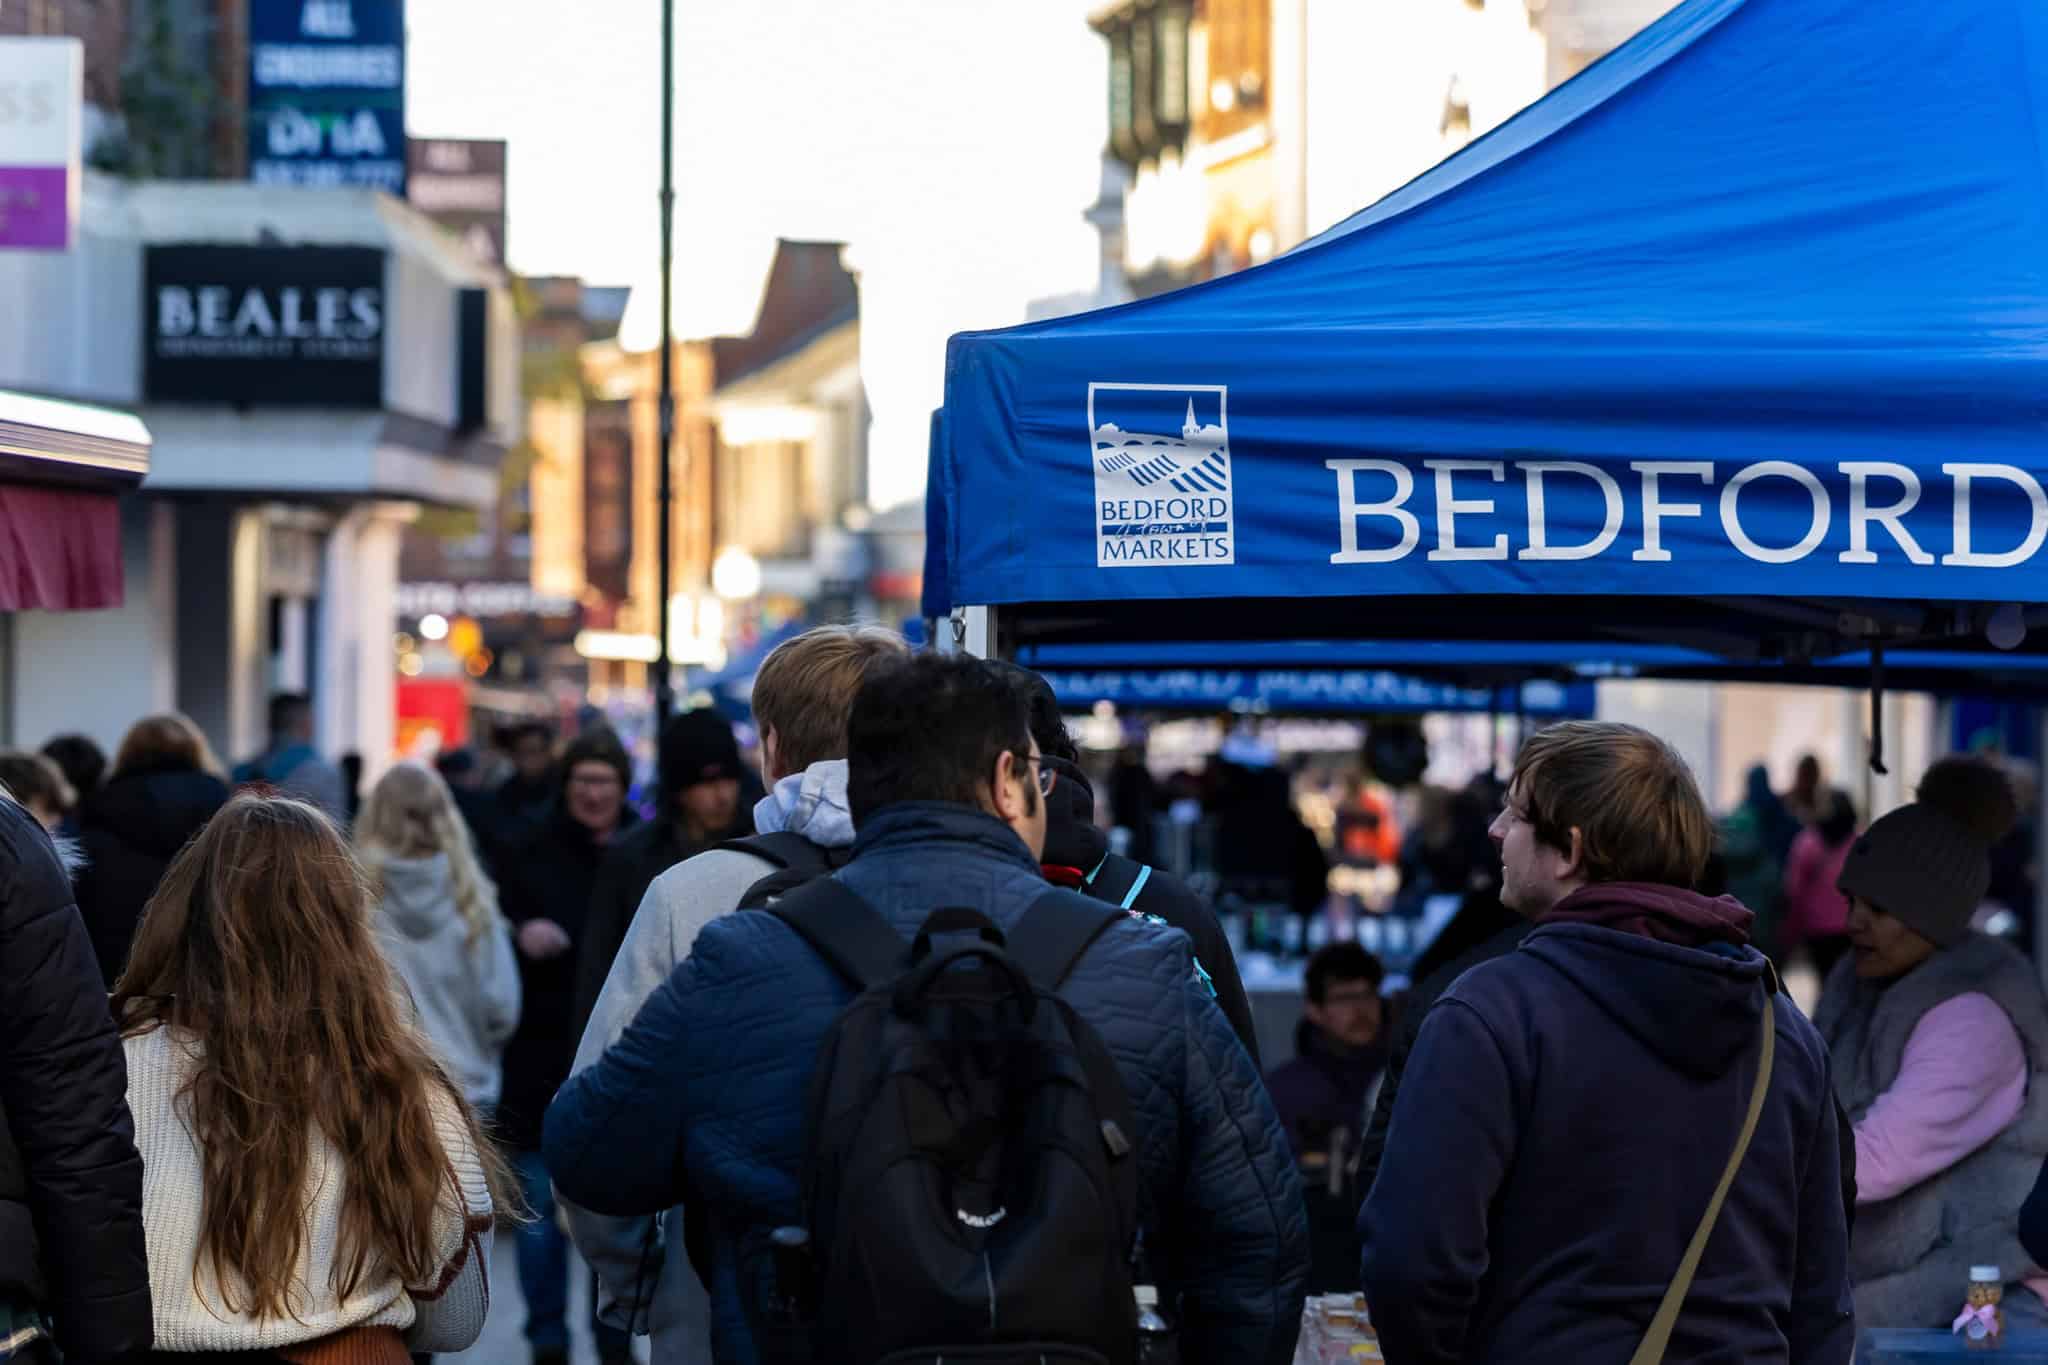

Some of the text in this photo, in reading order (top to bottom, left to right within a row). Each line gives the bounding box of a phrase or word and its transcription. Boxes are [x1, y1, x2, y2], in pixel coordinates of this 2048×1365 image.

[158, 285, 381, 339] BEALES
[1102, 498, 1227, 521] BEDFORD
[1325, 458, 2048, 568] BEDFORD
[1103, 537, 1229, 560] MARKETS
